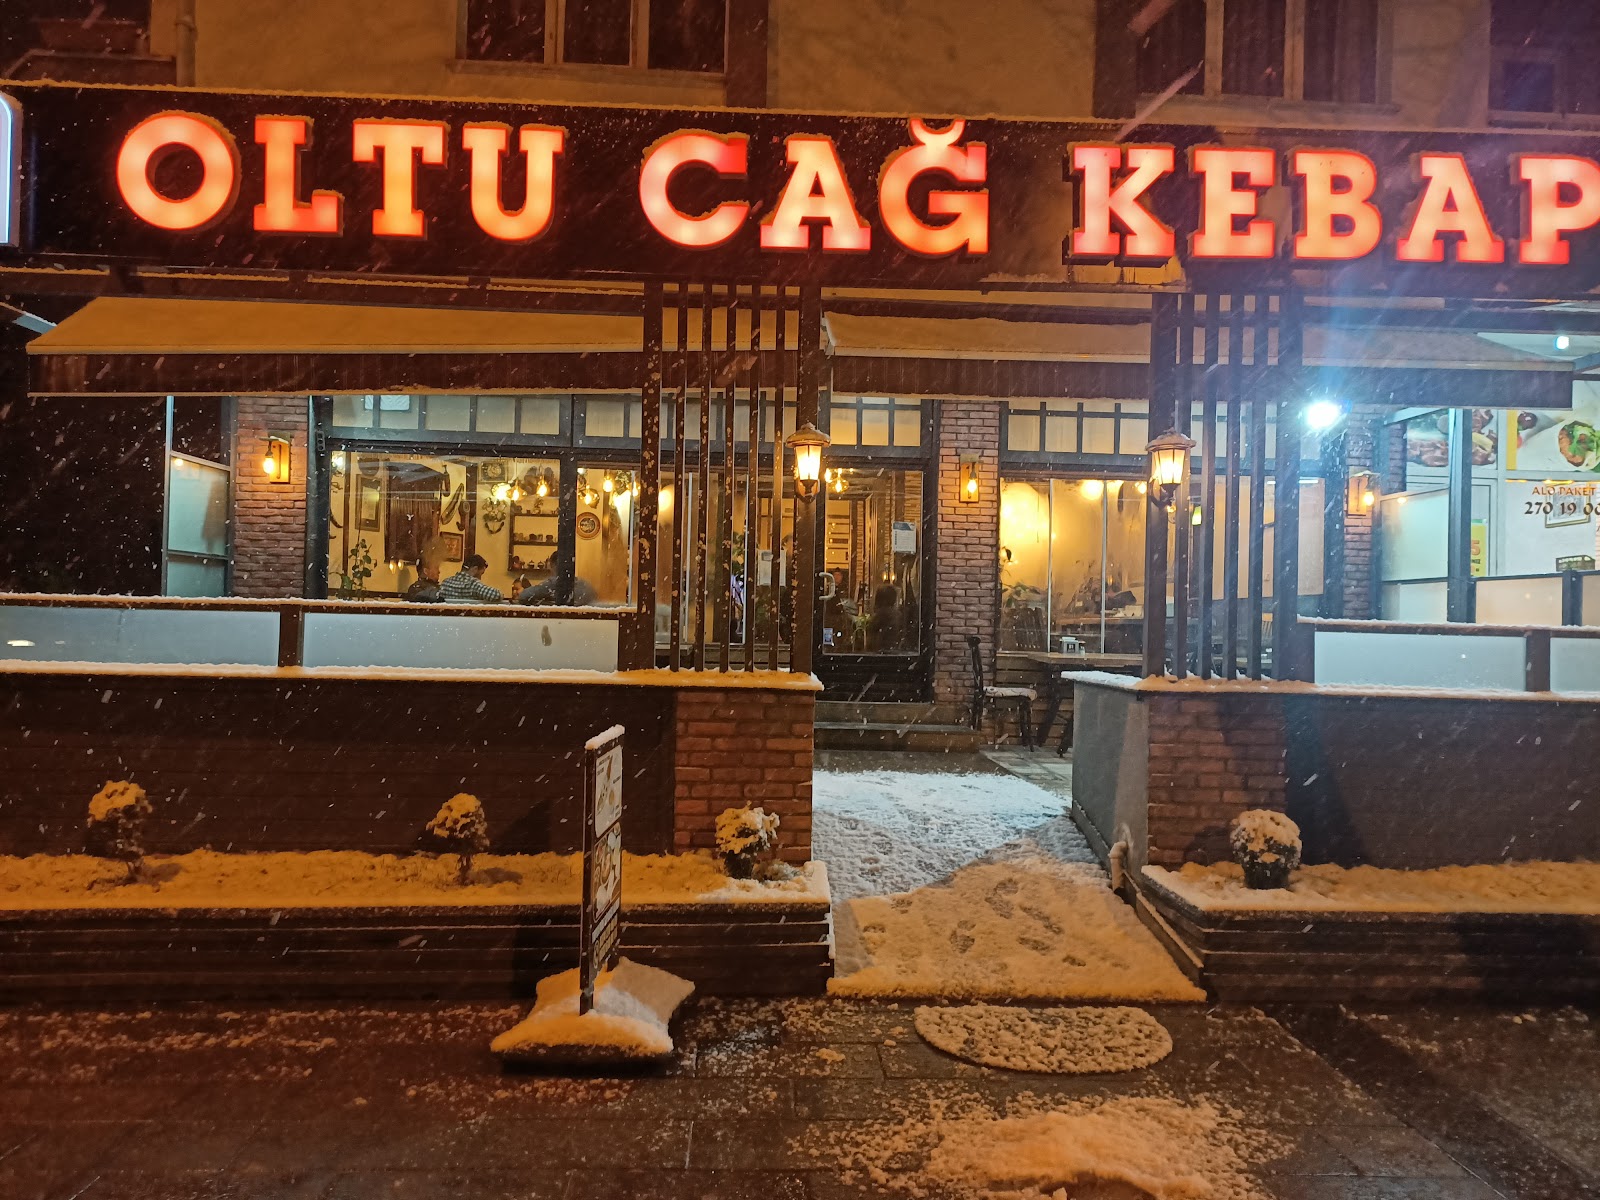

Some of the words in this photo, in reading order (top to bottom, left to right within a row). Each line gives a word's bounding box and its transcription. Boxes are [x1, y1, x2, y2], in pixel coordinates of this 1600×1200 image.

[116, 111, 565, 241] OLTU
[639, 117, 990, 255] CAĞ
[1072, 143, 1600, 265] KEBAP
[1532, 486, 1555, 495] ALO
[1559, 487, 1596, 495] PAKET
[1524, 501, 1553, 514] 270
[1560, 502, 1576, 516] 19
